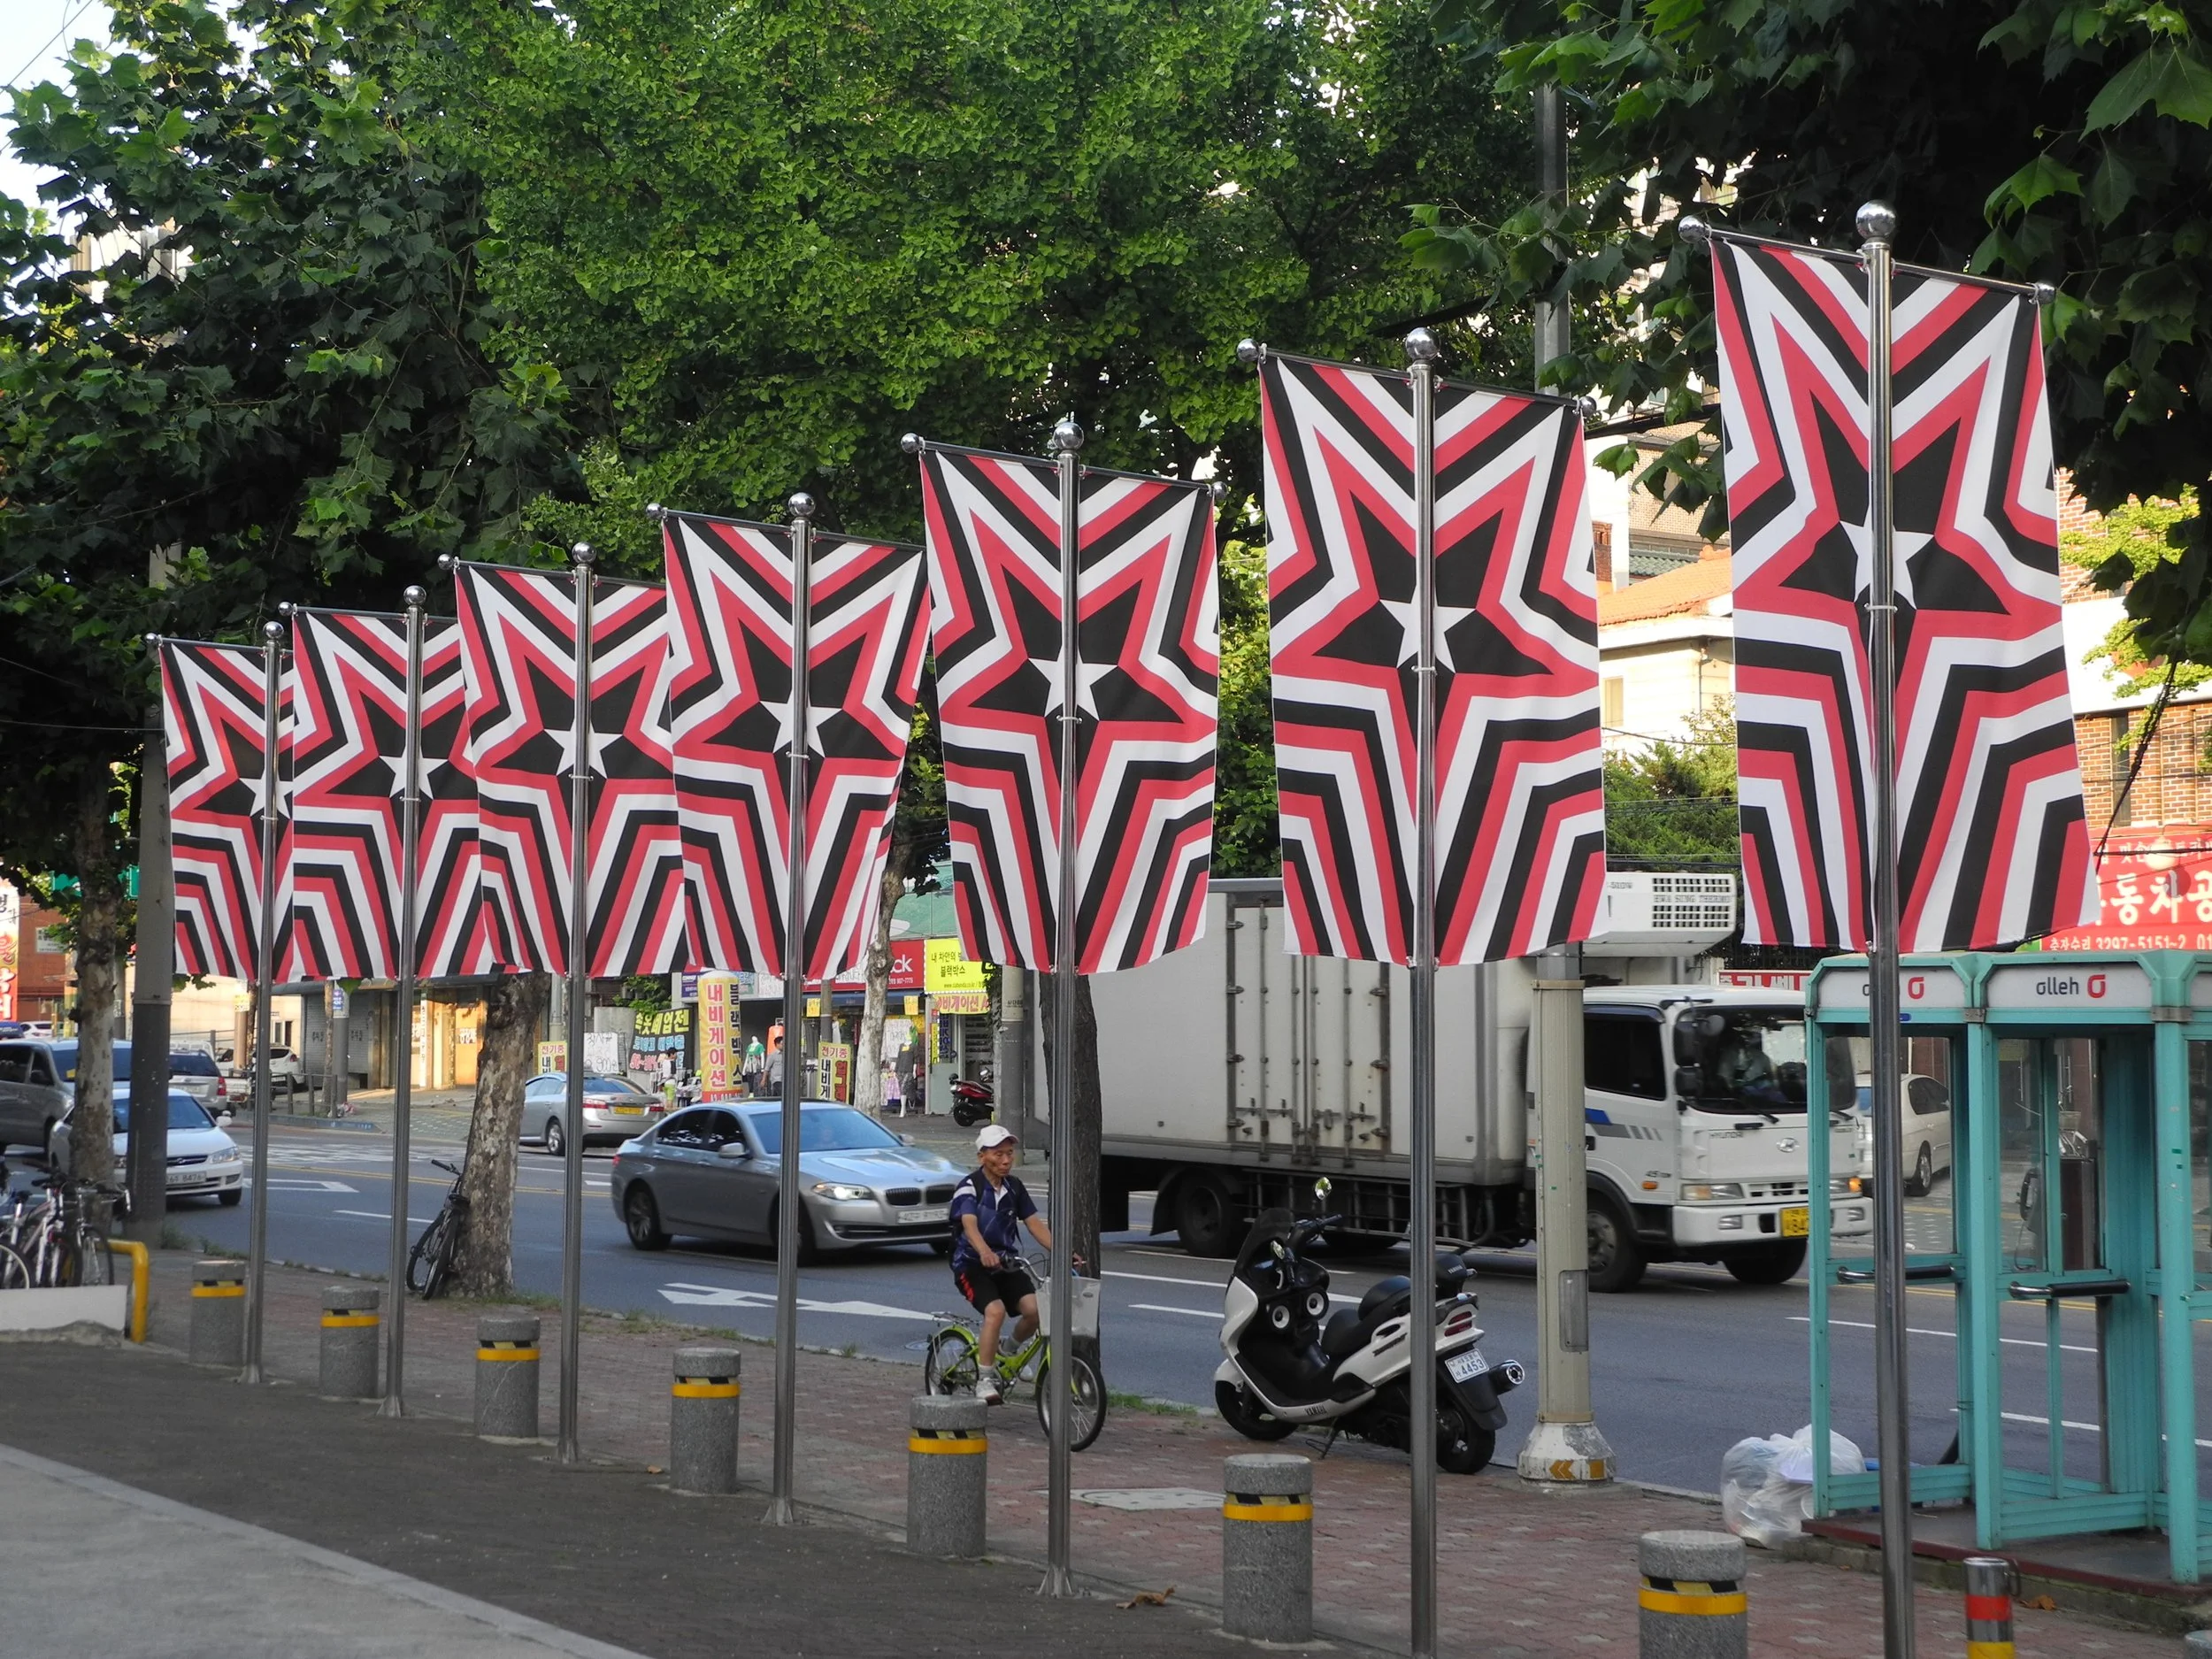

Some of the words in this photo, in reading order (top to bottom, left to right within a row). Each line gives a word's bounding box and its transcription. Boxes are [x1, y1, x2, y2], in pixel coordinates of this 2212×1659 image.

[941, 965, 965, 978] 블랙박스
[2036, 977, 2079, 995] olleh
[707, 984, 726, 1087] 내비게이션
[729, 984, 742, 1086] 블랙박스
[1462, 1359, 1485, 1376] 4453
